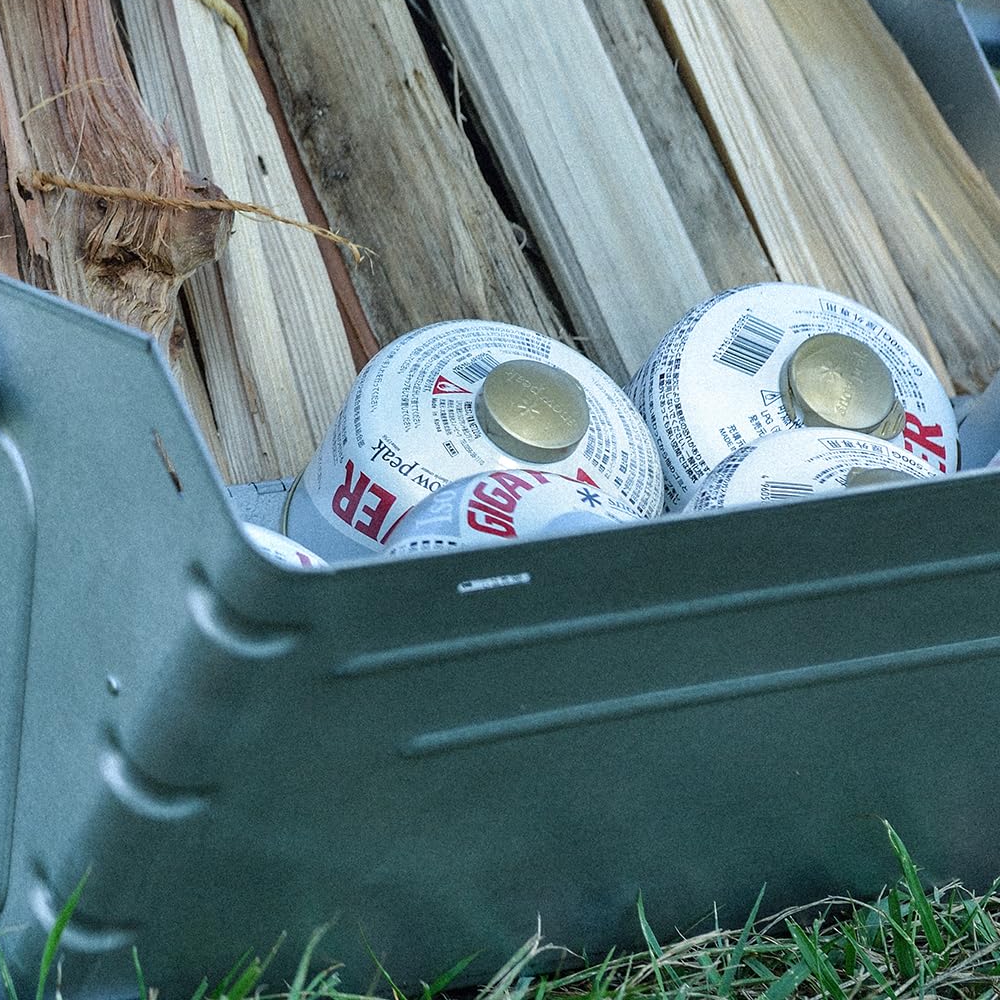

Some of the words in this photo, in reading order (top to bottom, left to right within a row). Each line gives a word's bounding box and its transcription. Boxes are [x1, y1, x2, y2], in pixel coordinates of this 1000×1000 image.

[760, 409, 774, 425] LPG
[719, 427, 734, 448] MADE
[371, 438, 420, 476] peak
[891, 450, 937, 478] P-500G
[410, 474, 444, 493] ow
[332, 459, 414, 545] ER
